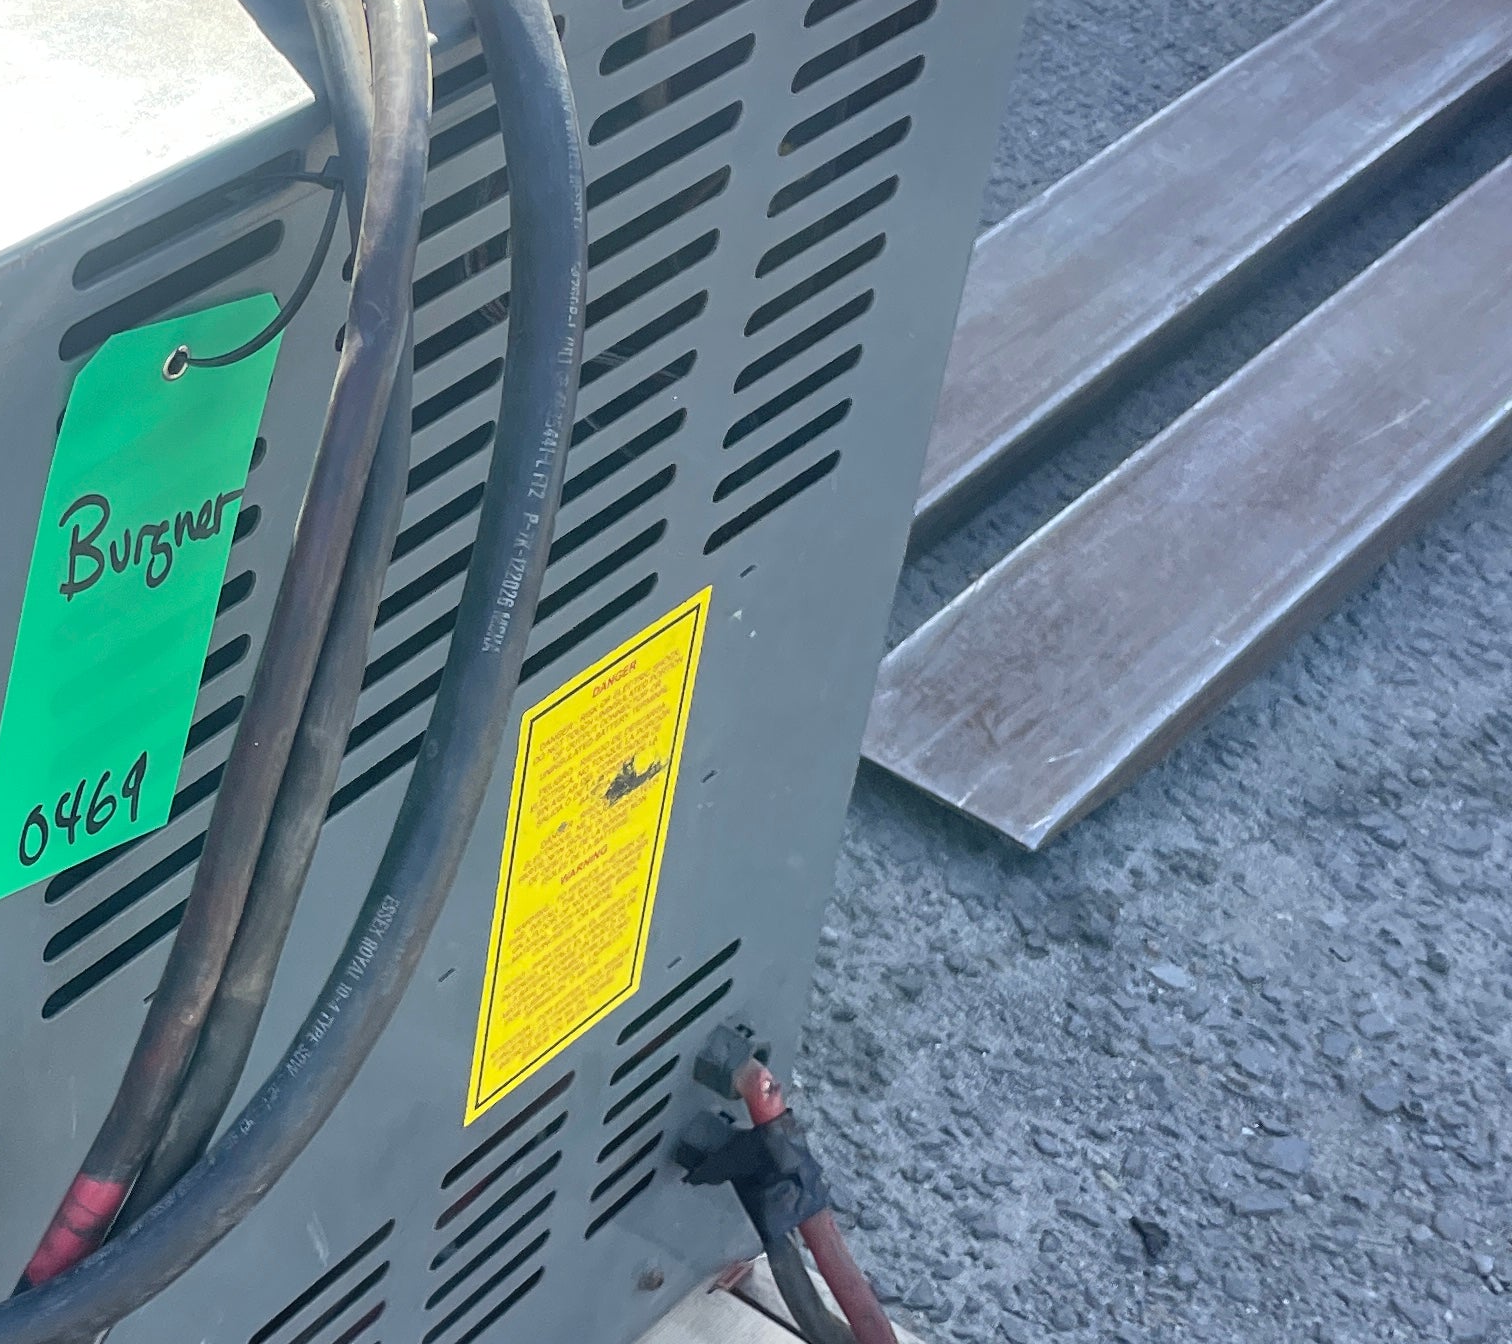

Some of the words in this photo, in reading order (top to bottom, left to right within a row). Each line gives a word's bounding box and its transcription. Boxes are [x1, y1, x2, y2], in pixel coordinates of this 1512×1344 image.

[591, 658, 638, 699] DANGER
[560, 842, 609, 886] WARNING
[369, 894, 400, 941] ESSEX
[346, 936, 378, 981] ROYAL
[305, 1011, 335, 1044] TYPE
